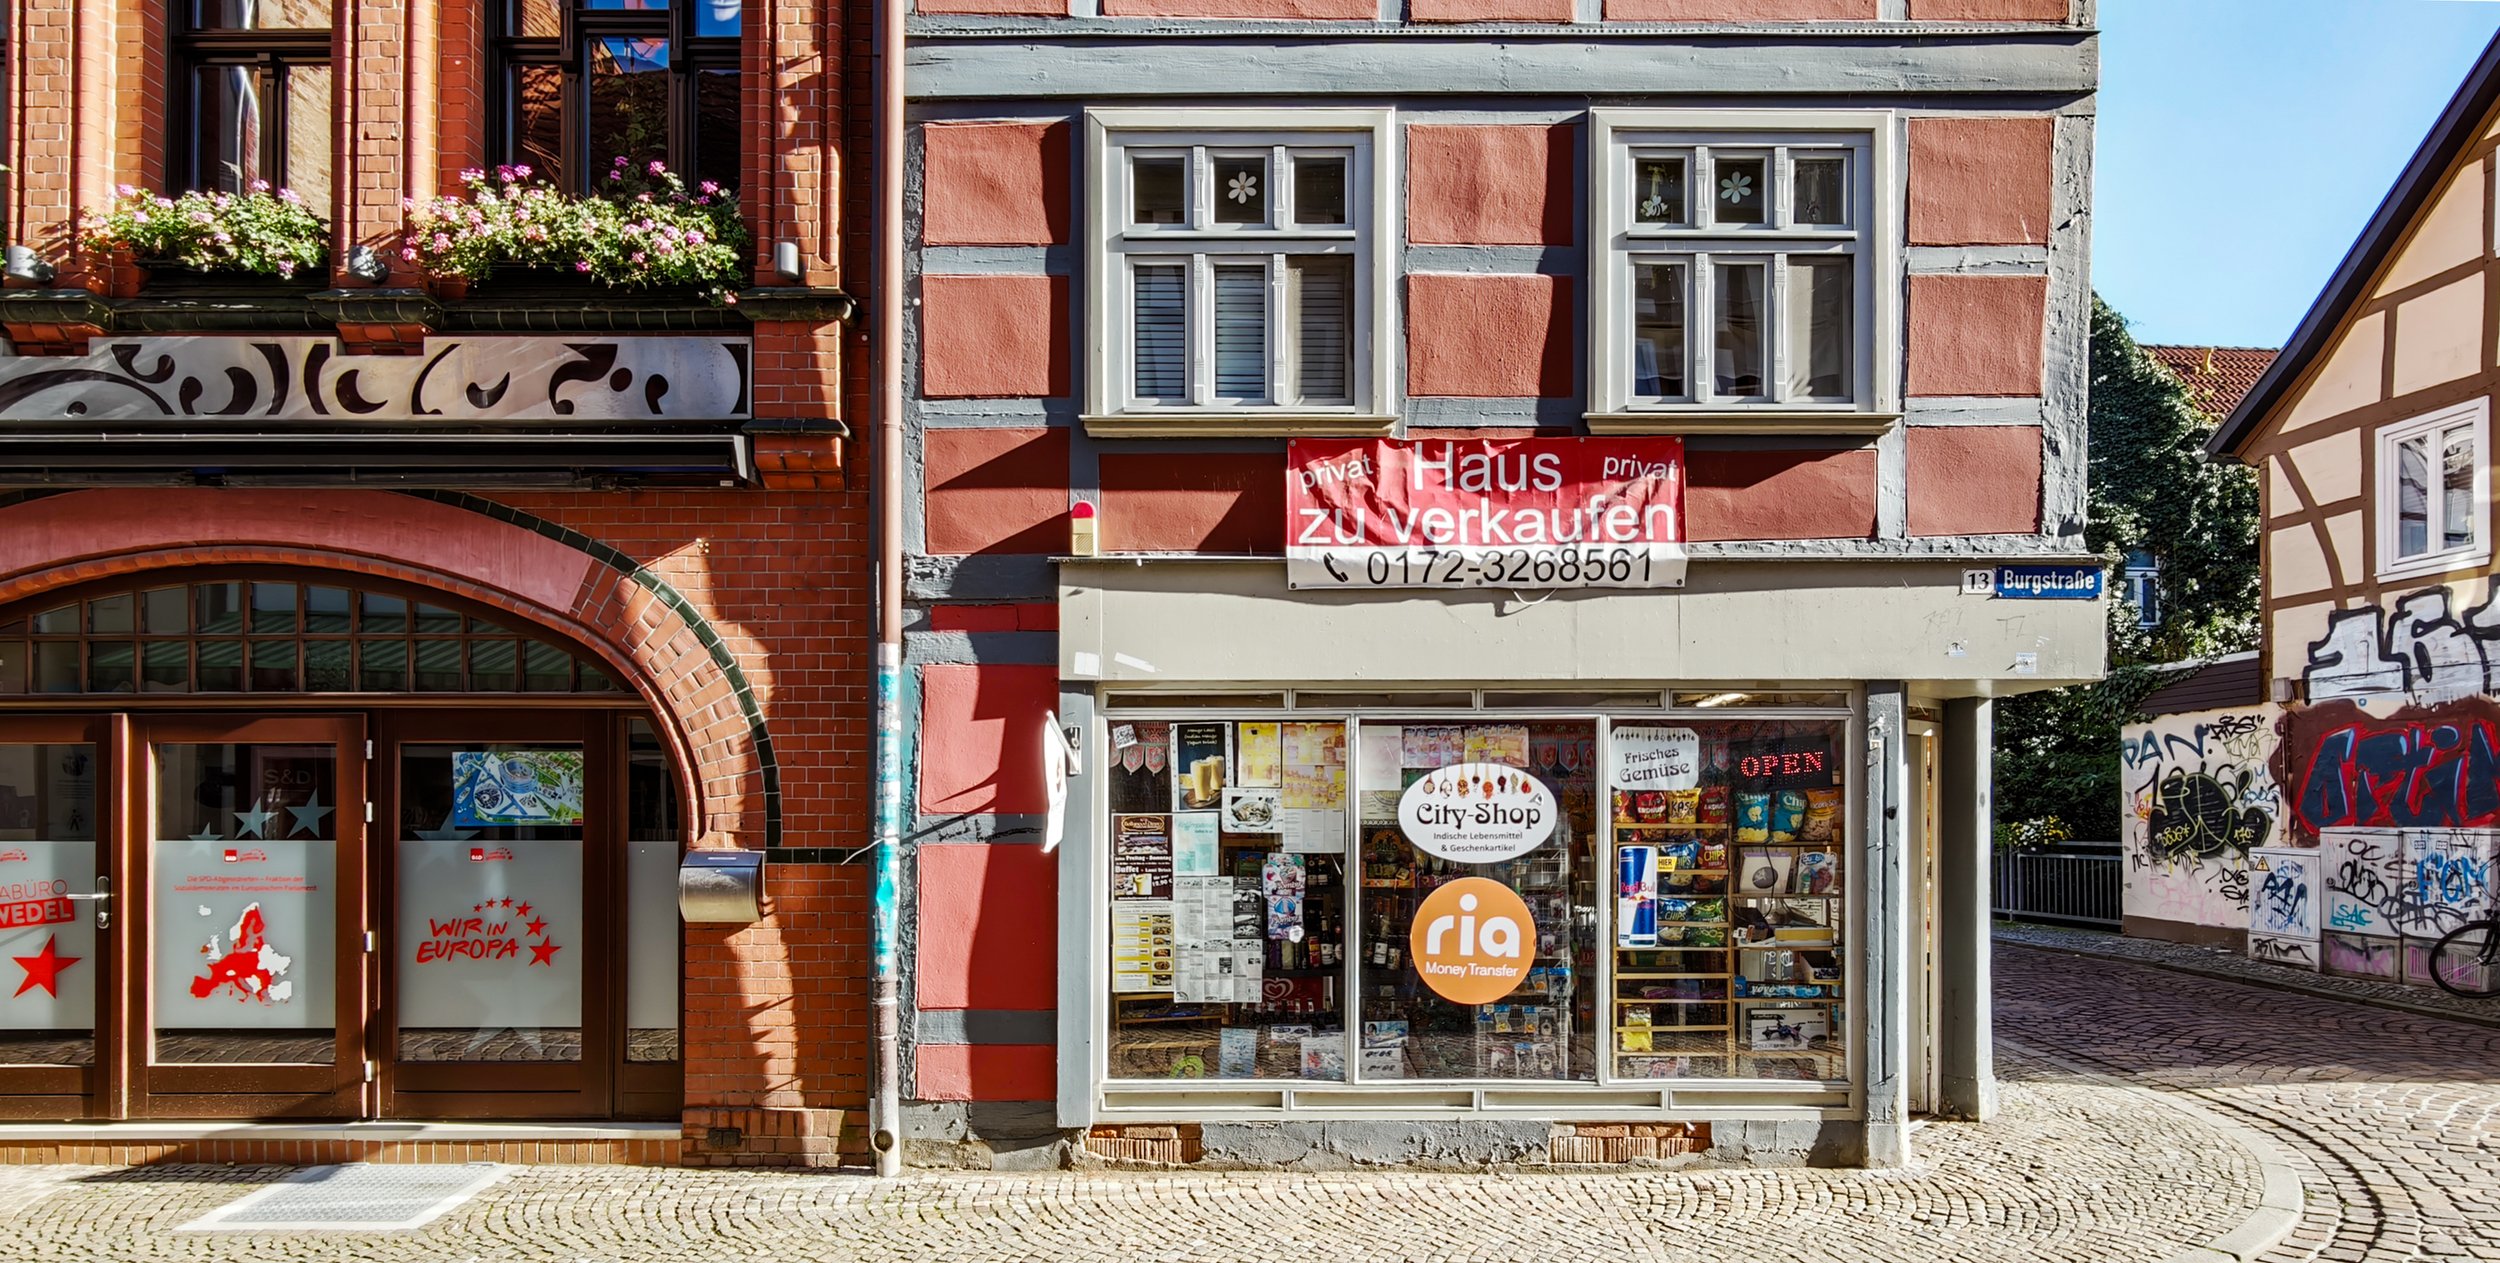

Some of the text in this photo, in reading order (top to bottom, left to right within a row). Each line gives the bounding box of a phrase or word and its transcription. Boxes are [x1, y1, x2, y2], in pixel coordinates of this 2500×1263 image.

[1299, 454, 1374, 495] privat
[1413, 441, 1563, 492] Haus
[1602, 454, 1678, 482] privat
[1298, 495, 1676, 545] zu verkaufen
[1366, 548, 1651, 585] 0172-3268561
[1968, 572, 1990, 590] 13
[2003, 569, 2095, 595] Burgstraße
[1624, 747, 1680, 764] Frisches
[1740, 751, 1824, 777] OPEN
[263, 768, 312, 786] S&D
[1619, 763, 1690, 783] Gemüse
[1416, 802, 1542, 830] City-Shop
[1433, 831, 1523, 840] Indische Lebensmittel
[1440, 844, 1516, 852] & Geschenkartikel
[429, 917, 509, 938] WIR IN
[1426, 893, 1520, 958] ria
[416, 937, 520, 964] EUROPA
[1425, 961, 1519, 978] Money Transfer
